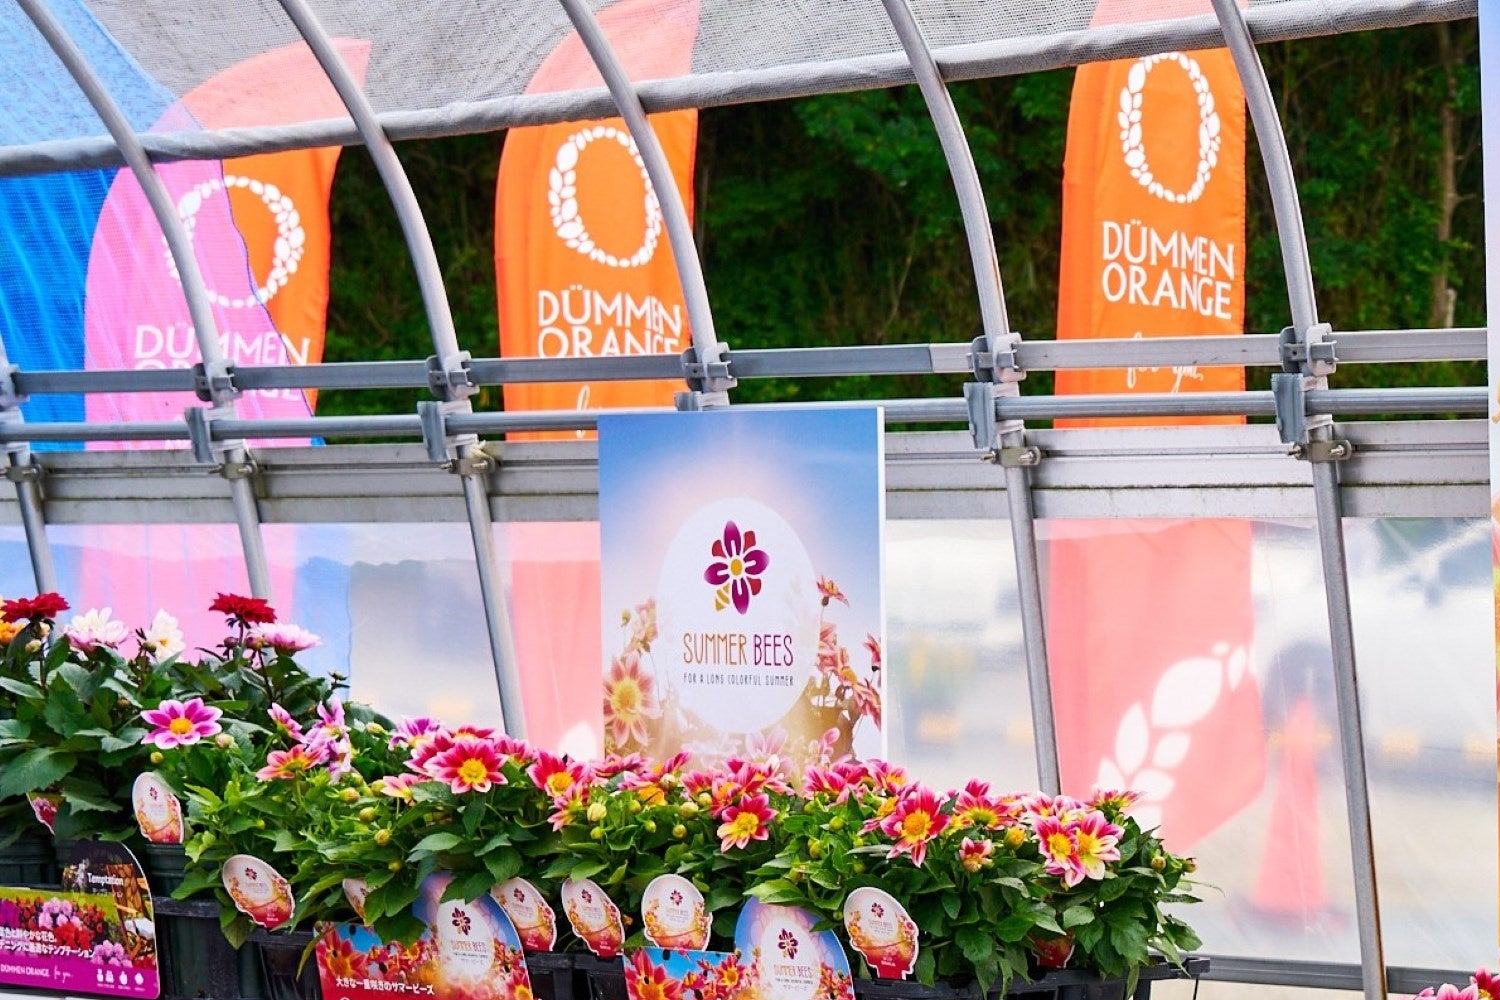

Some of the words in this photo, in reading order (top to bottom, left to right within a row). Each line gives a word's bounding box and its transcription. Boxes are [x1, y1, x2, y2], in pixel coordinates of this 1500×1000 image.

[1102, 219, 1235, 281] DÜMMEN
[538, 284, 682, 338] DÜMMEN
[1102, 262, 1232, 320] ORANGE
[683, 632, 747, 665] SUMMER
[754, 633, 794, 667] BEES
[683, 672, 697, 683] FOR
[706, 673, 725, 685] LONG
[727, 674, 762, 686] COLORFUL
[765, 675, 794, 687] SUMMER
